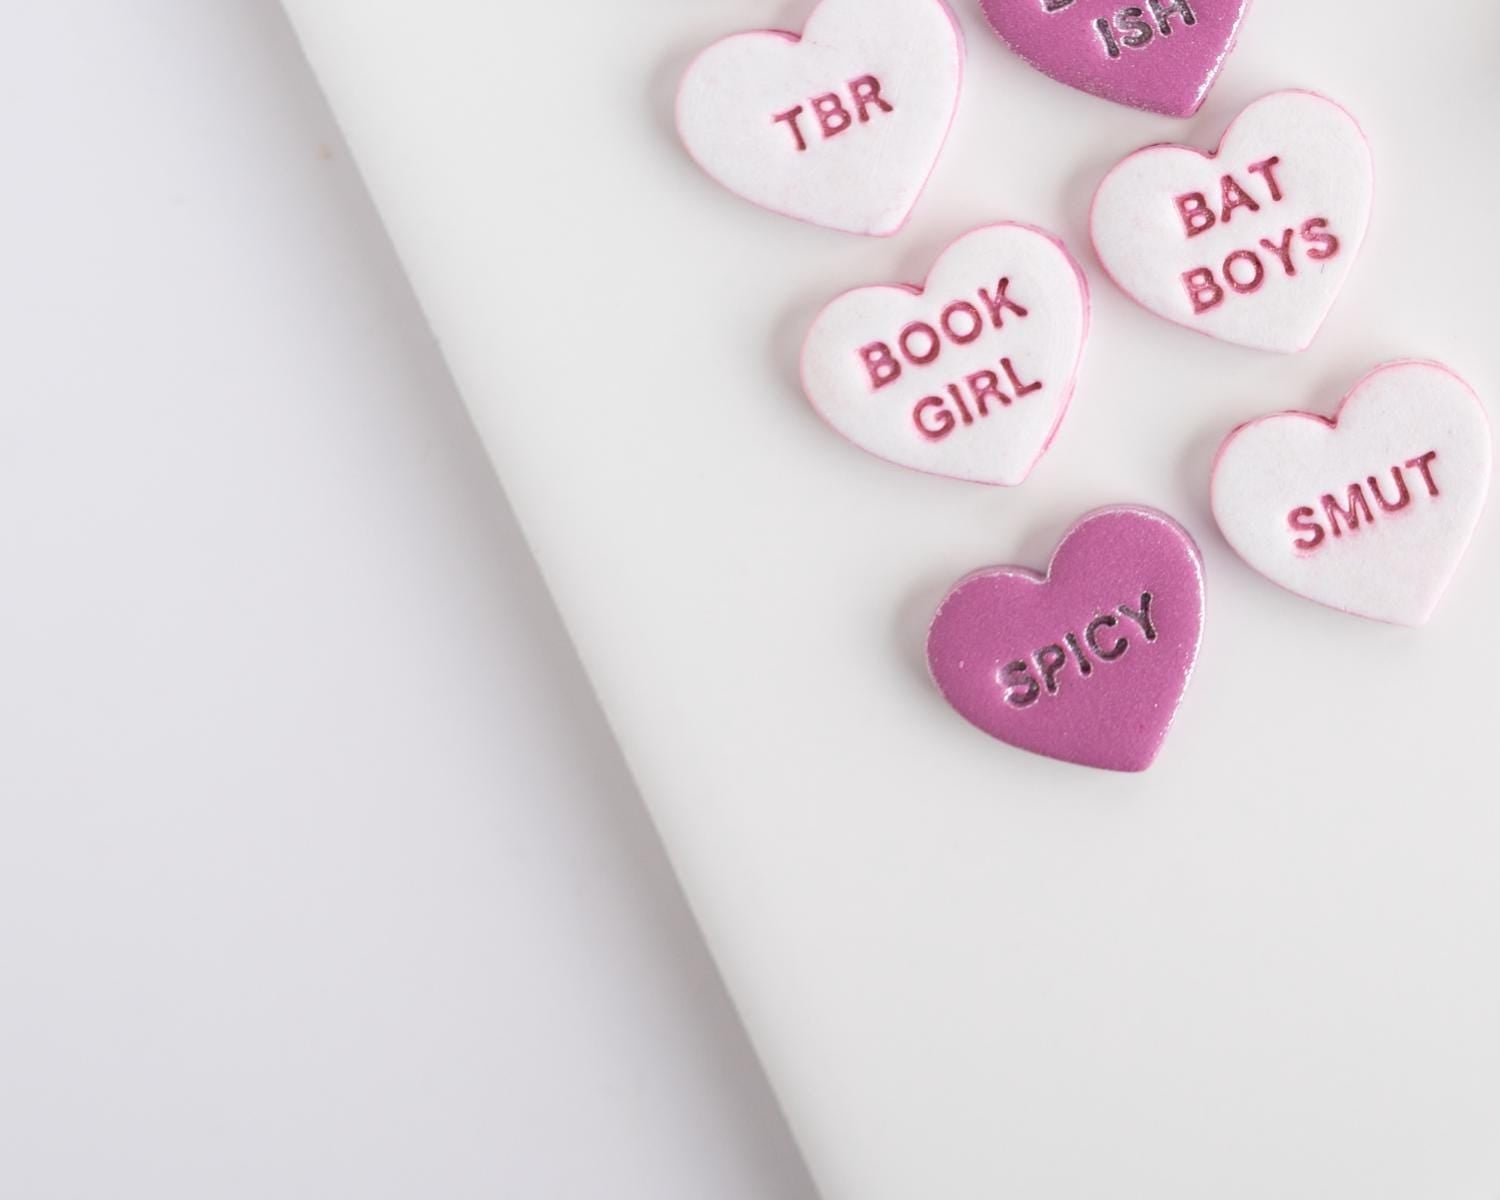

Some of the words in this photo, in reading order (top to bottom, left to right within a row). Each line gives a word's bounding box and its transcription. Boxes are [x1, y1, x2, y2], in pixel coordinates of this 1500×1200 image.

[772, 73, 895, 152] TBR
[1175, 155, 1284, 238] BAT
[1181, 217, 1341, 315] BOYS
[856, 276, 1028, 390] BOOK
[911, 356, 1042, 443] GIRL
[1286, 449, 1442, 555] SMUT
[998, 591, 1156, 709] SPICY
